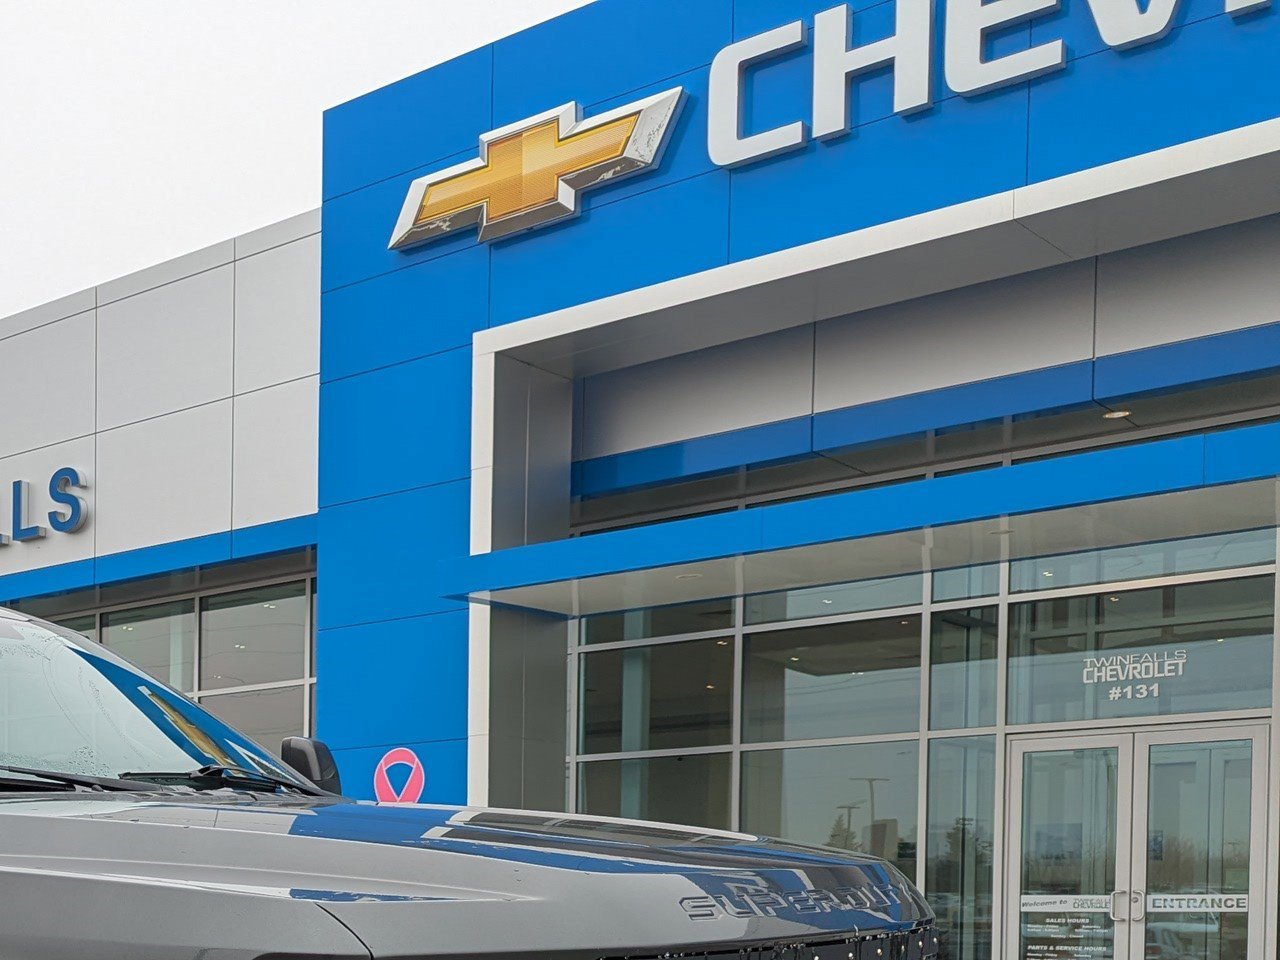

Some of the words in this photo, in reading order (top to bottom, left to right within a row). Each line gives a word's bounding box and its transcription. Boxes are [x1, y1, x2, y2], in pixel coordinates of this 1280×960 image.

[708, 0, 1269, 168] CHE
[1083, 649, 1187, 668] TWINFALLS
[1083, 659, 1187, 683] CHEVROLET
[1109, 683, 1159, 700] #131
[1022, 900, 1057, 908] Welcome
[1152, 897, 1247, 909] ENTRANCE
